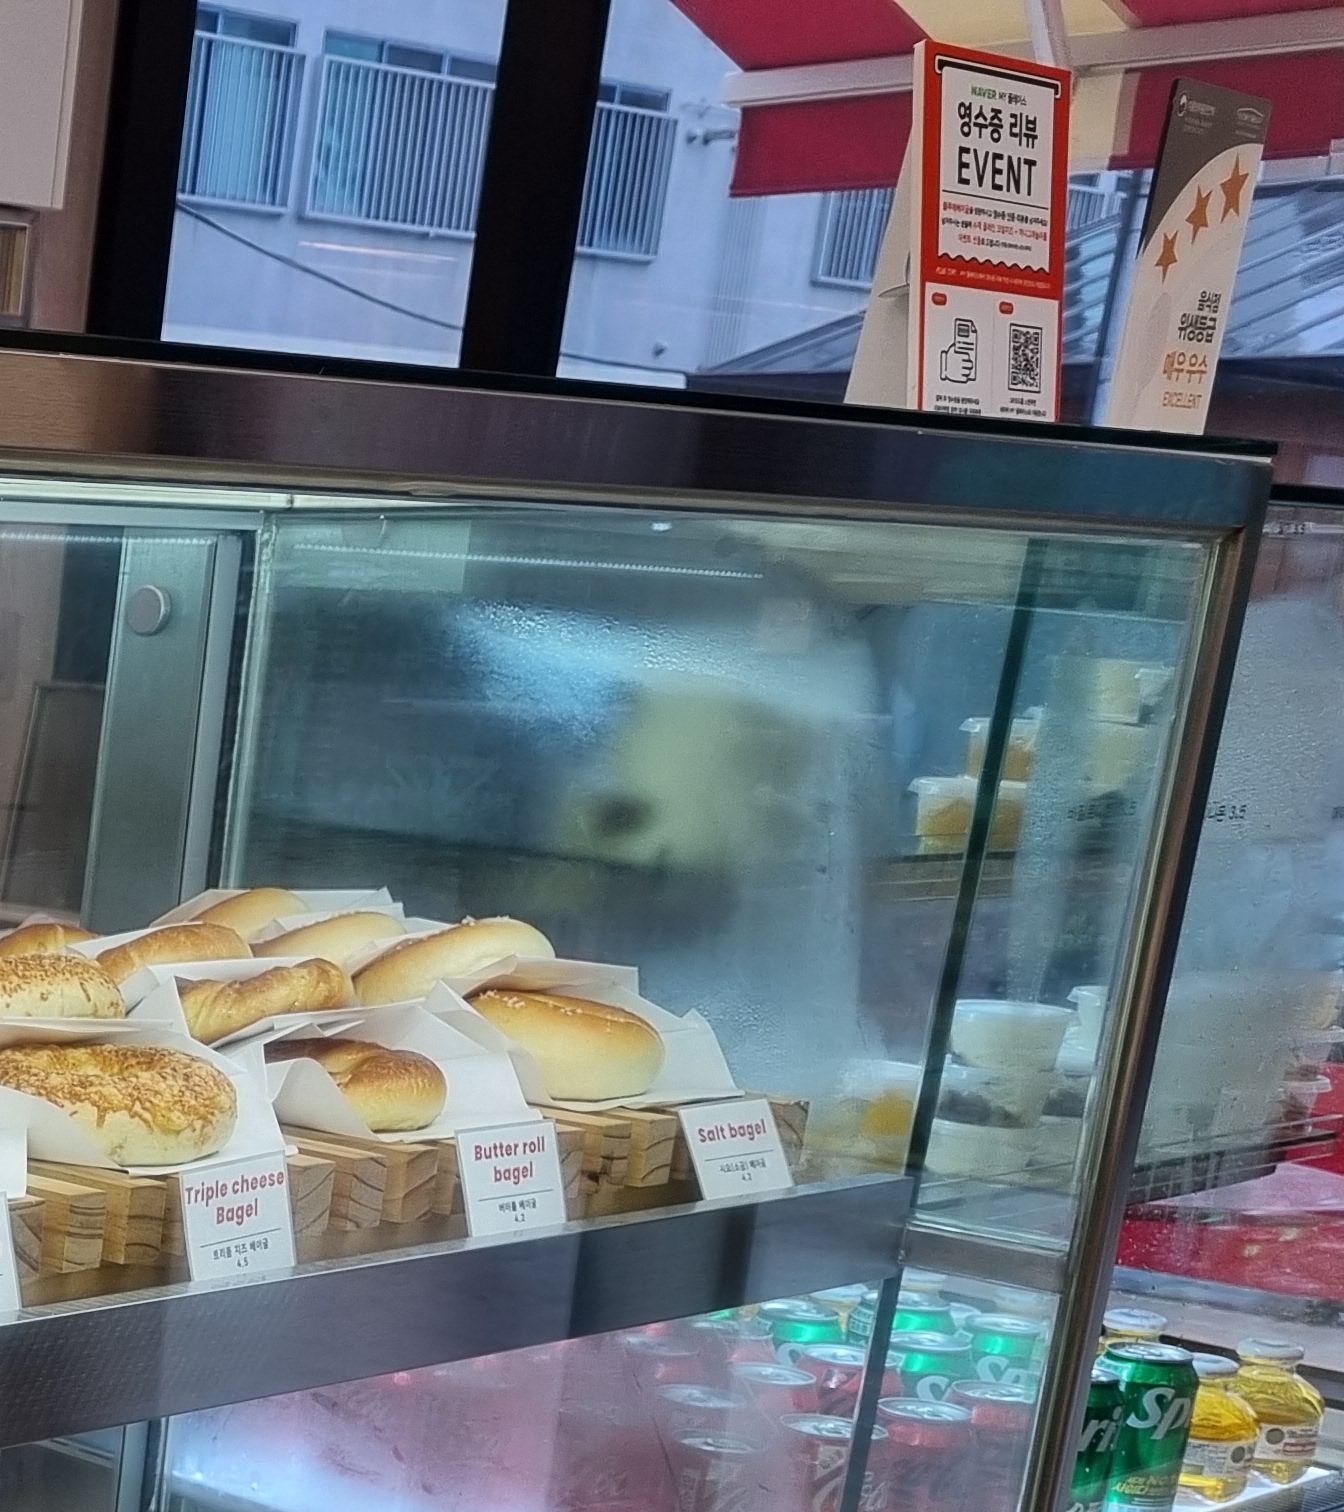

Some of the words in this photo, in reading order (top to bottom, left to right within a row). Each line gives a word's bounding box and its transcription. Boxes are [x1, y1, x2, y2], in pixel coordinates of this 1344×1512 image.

[958, 102, 1003, 143] 영수증
[1009, 112, 1038, 149] 리뷰
[958, 146, 1037, 196] EVENT
[698, 1125, 726, 1142] Salt
[729, 1119, 766, 1141] bagel
[475, 1142, 519, 1160] Butter
[523, 1136, 544, 1154] roll
[494, 1162, 533, 1185] bagel
[185, 1180, 227, 1207] Triple
[233, 1171, 284, 1195] cheese
[216, 1198, 258, 1226] Bagel
